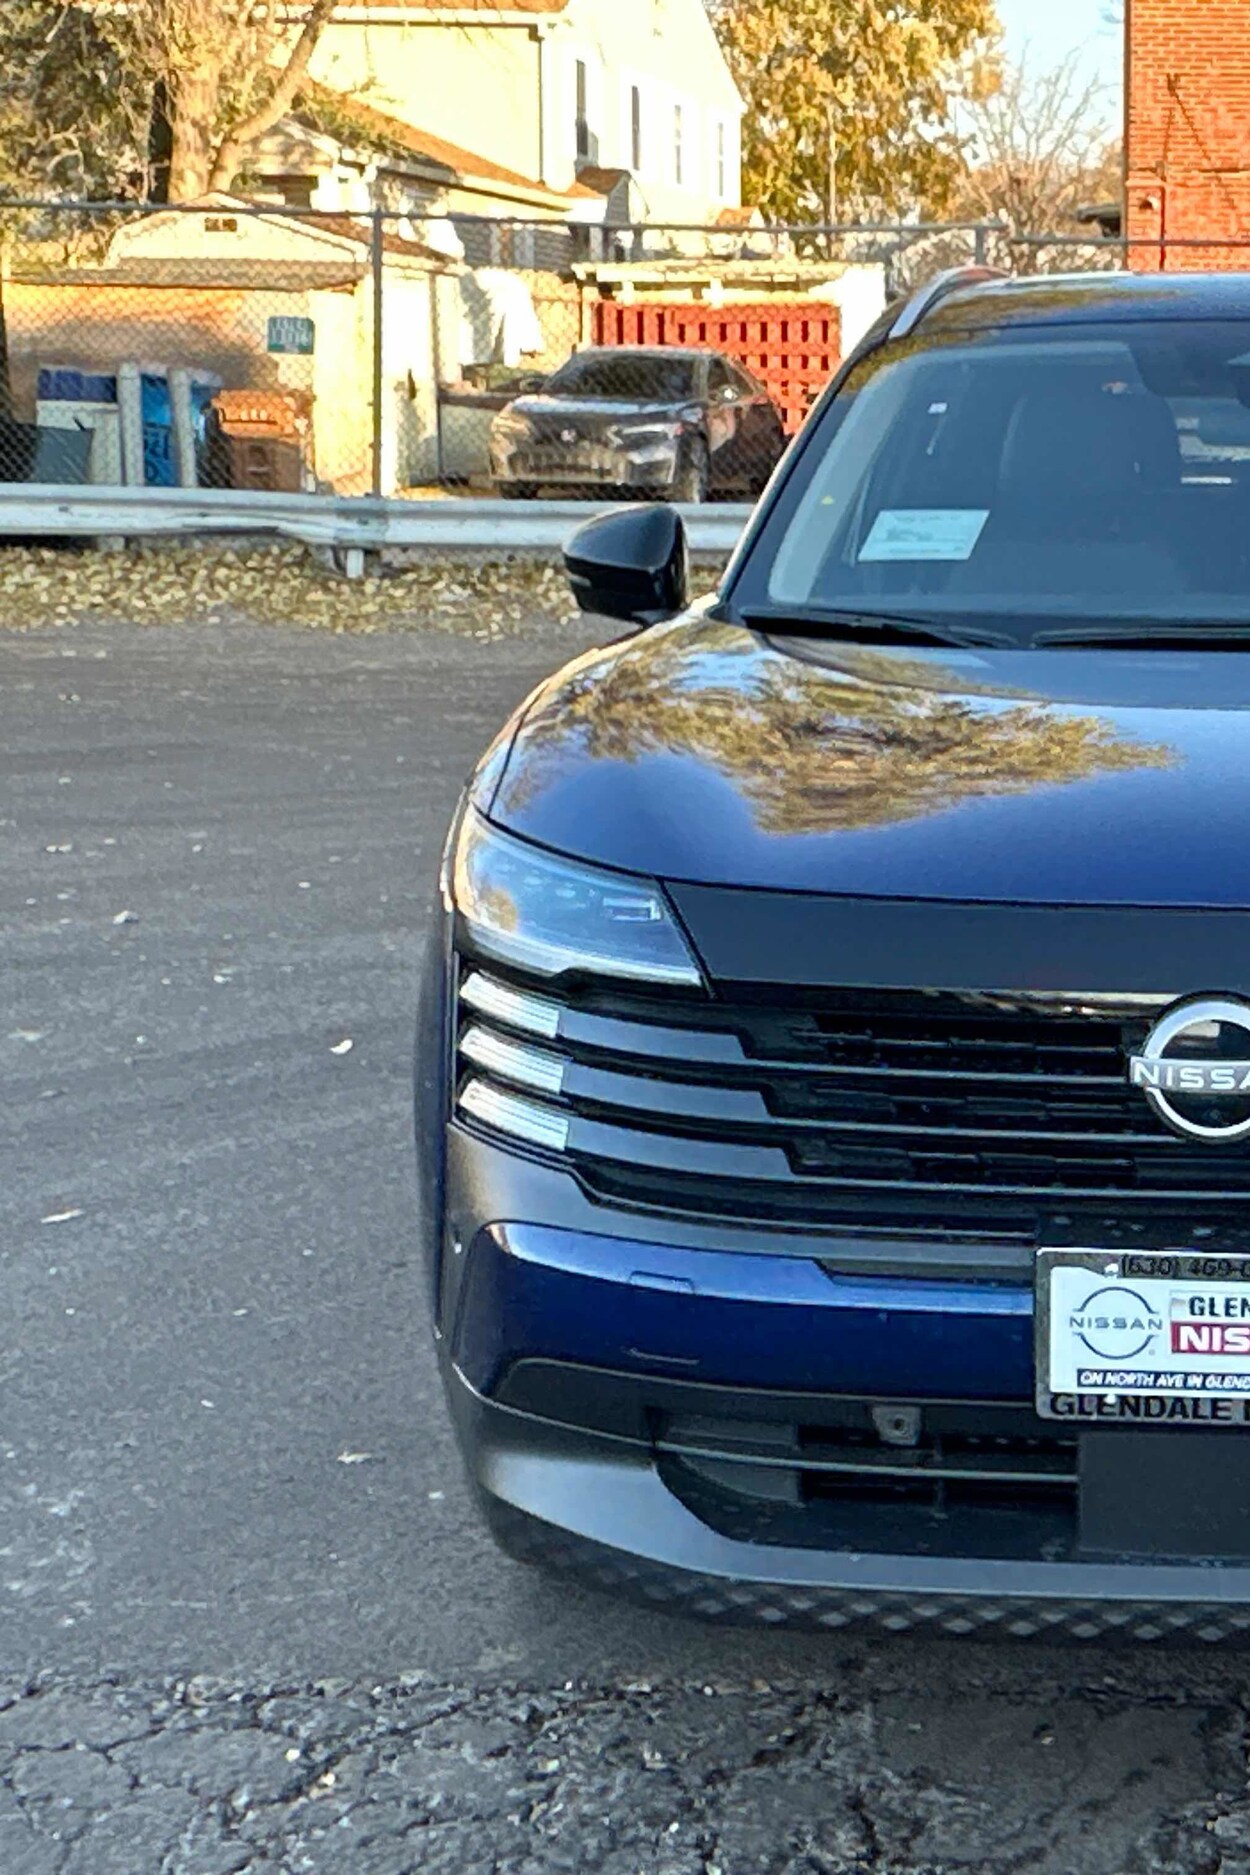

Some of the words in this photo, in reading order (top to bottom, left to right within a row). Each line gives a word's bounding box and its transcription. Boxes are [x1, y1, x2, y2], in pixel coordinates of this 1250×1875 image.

[1121, 1253, 1179, 1278] (630)
[1069, 1316, 1163, 1331] NISSAN
[1080, 1370, 1103, 1386] ON
[1104, 1372, 1155, 1387] NORTH
[1156, 1373, 1184, 1388] AVE
[1186, 1374, 1203, 1388] IN
[1049, 1393, 1233, 1420] GLENDALE
